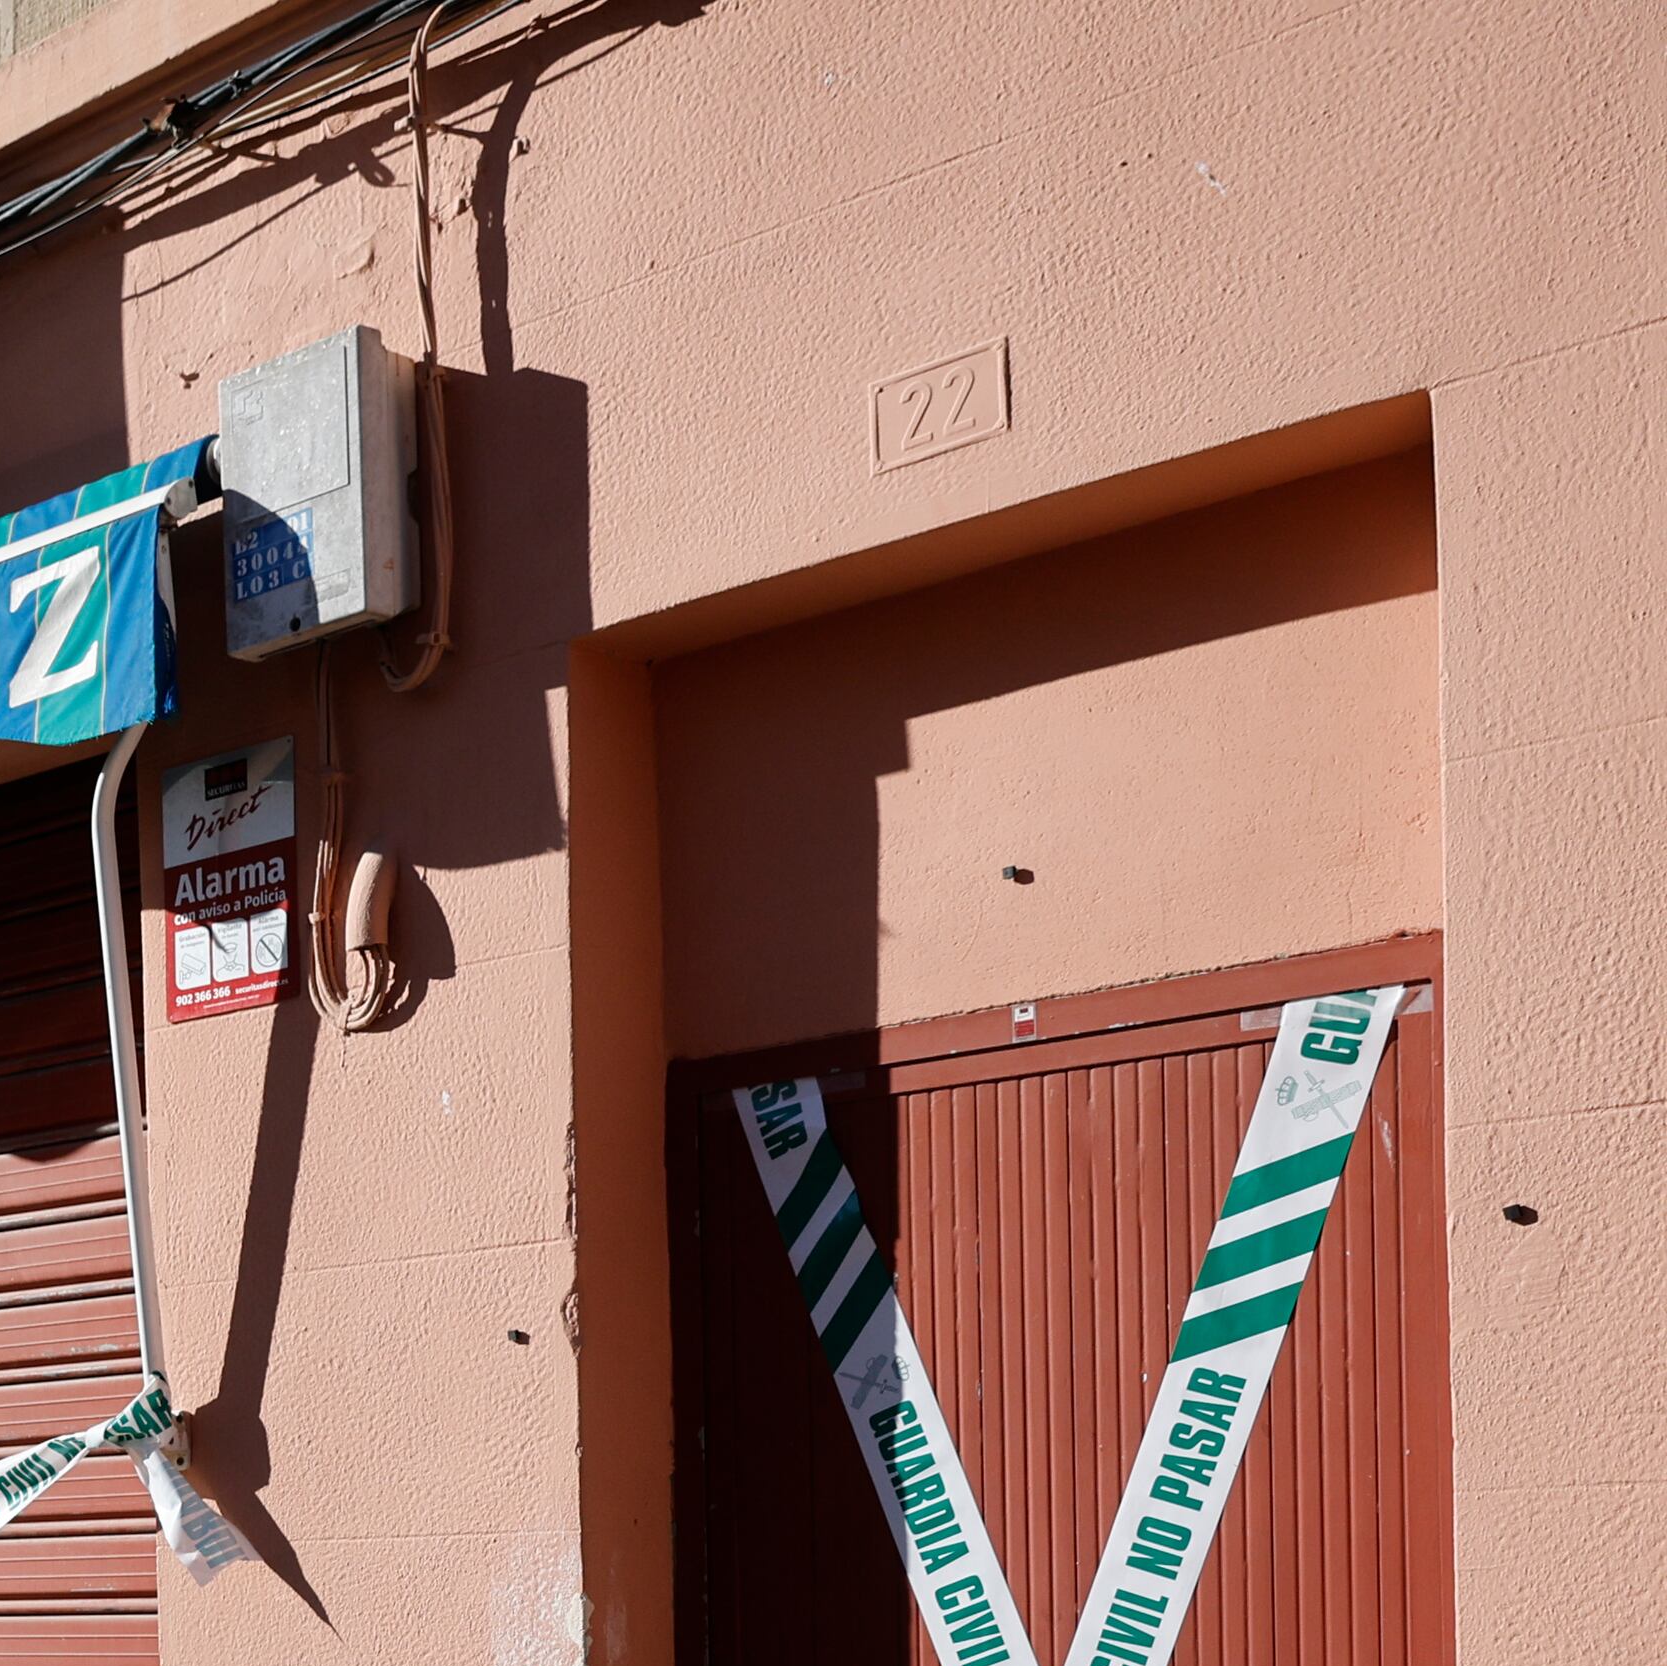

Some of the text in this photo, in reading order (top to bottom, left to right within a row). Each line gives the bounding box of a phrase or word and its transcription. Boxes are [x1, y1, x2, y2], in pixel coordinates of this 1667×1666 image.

[899, 366, 976, 452] 22
[185, 784, 274, 852] Direct
[173, 855, 286, 908] Alarma
[173, 888, 287, 926] con aviso a Policía
[175, 993, 194, 1007] 902
[194, 989, 212, 1004] 366
[212, 985, 231, 1001] 366
[1149, 1366, 1249, 1513] PASAR
[867, 1398, 970, 1573] GUARDIA
[1125, 1516, 1193, 1581] NO
